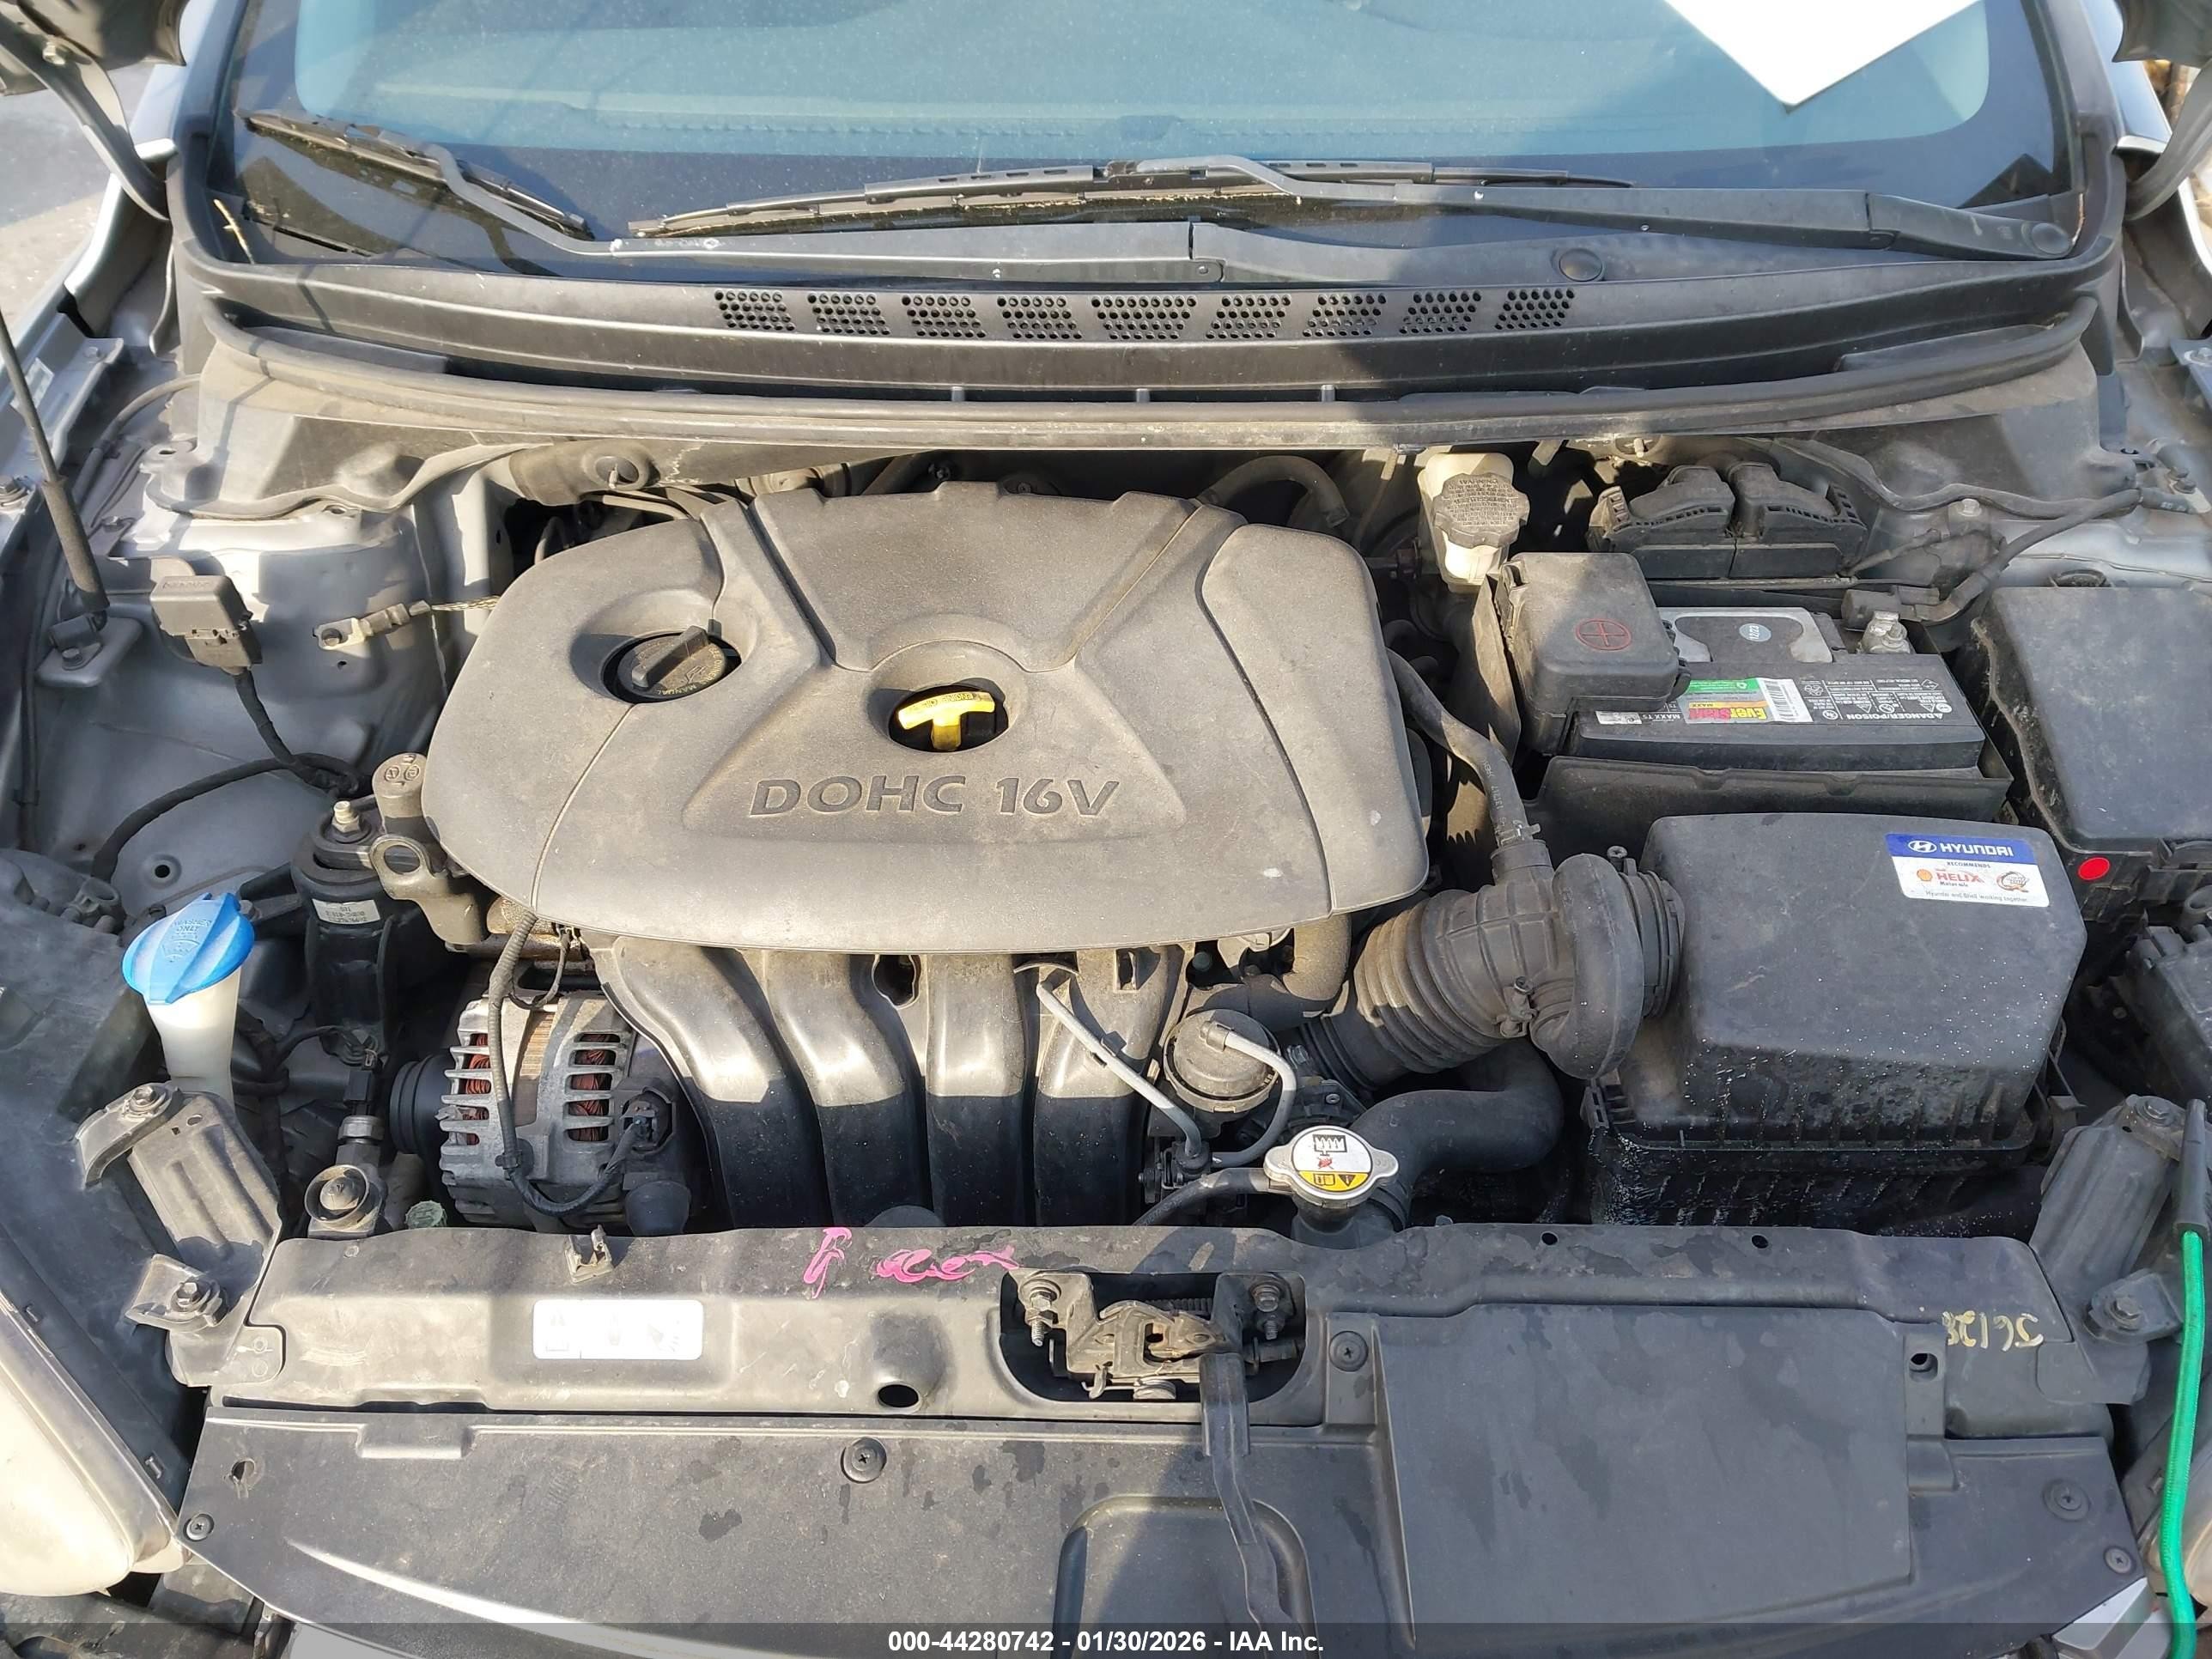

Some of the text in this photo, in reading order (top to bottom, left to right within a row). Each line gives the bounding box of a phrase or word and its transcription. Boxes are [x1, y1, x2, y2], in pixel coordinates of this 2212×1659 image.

[1688, 708, 1767, 720] EverStart
[750, 775, 1121, 817] DOHC 16V
[1941, 842, 2014, 857] HYUNDAI
[1936, 872, 1981, 884] HELIX
